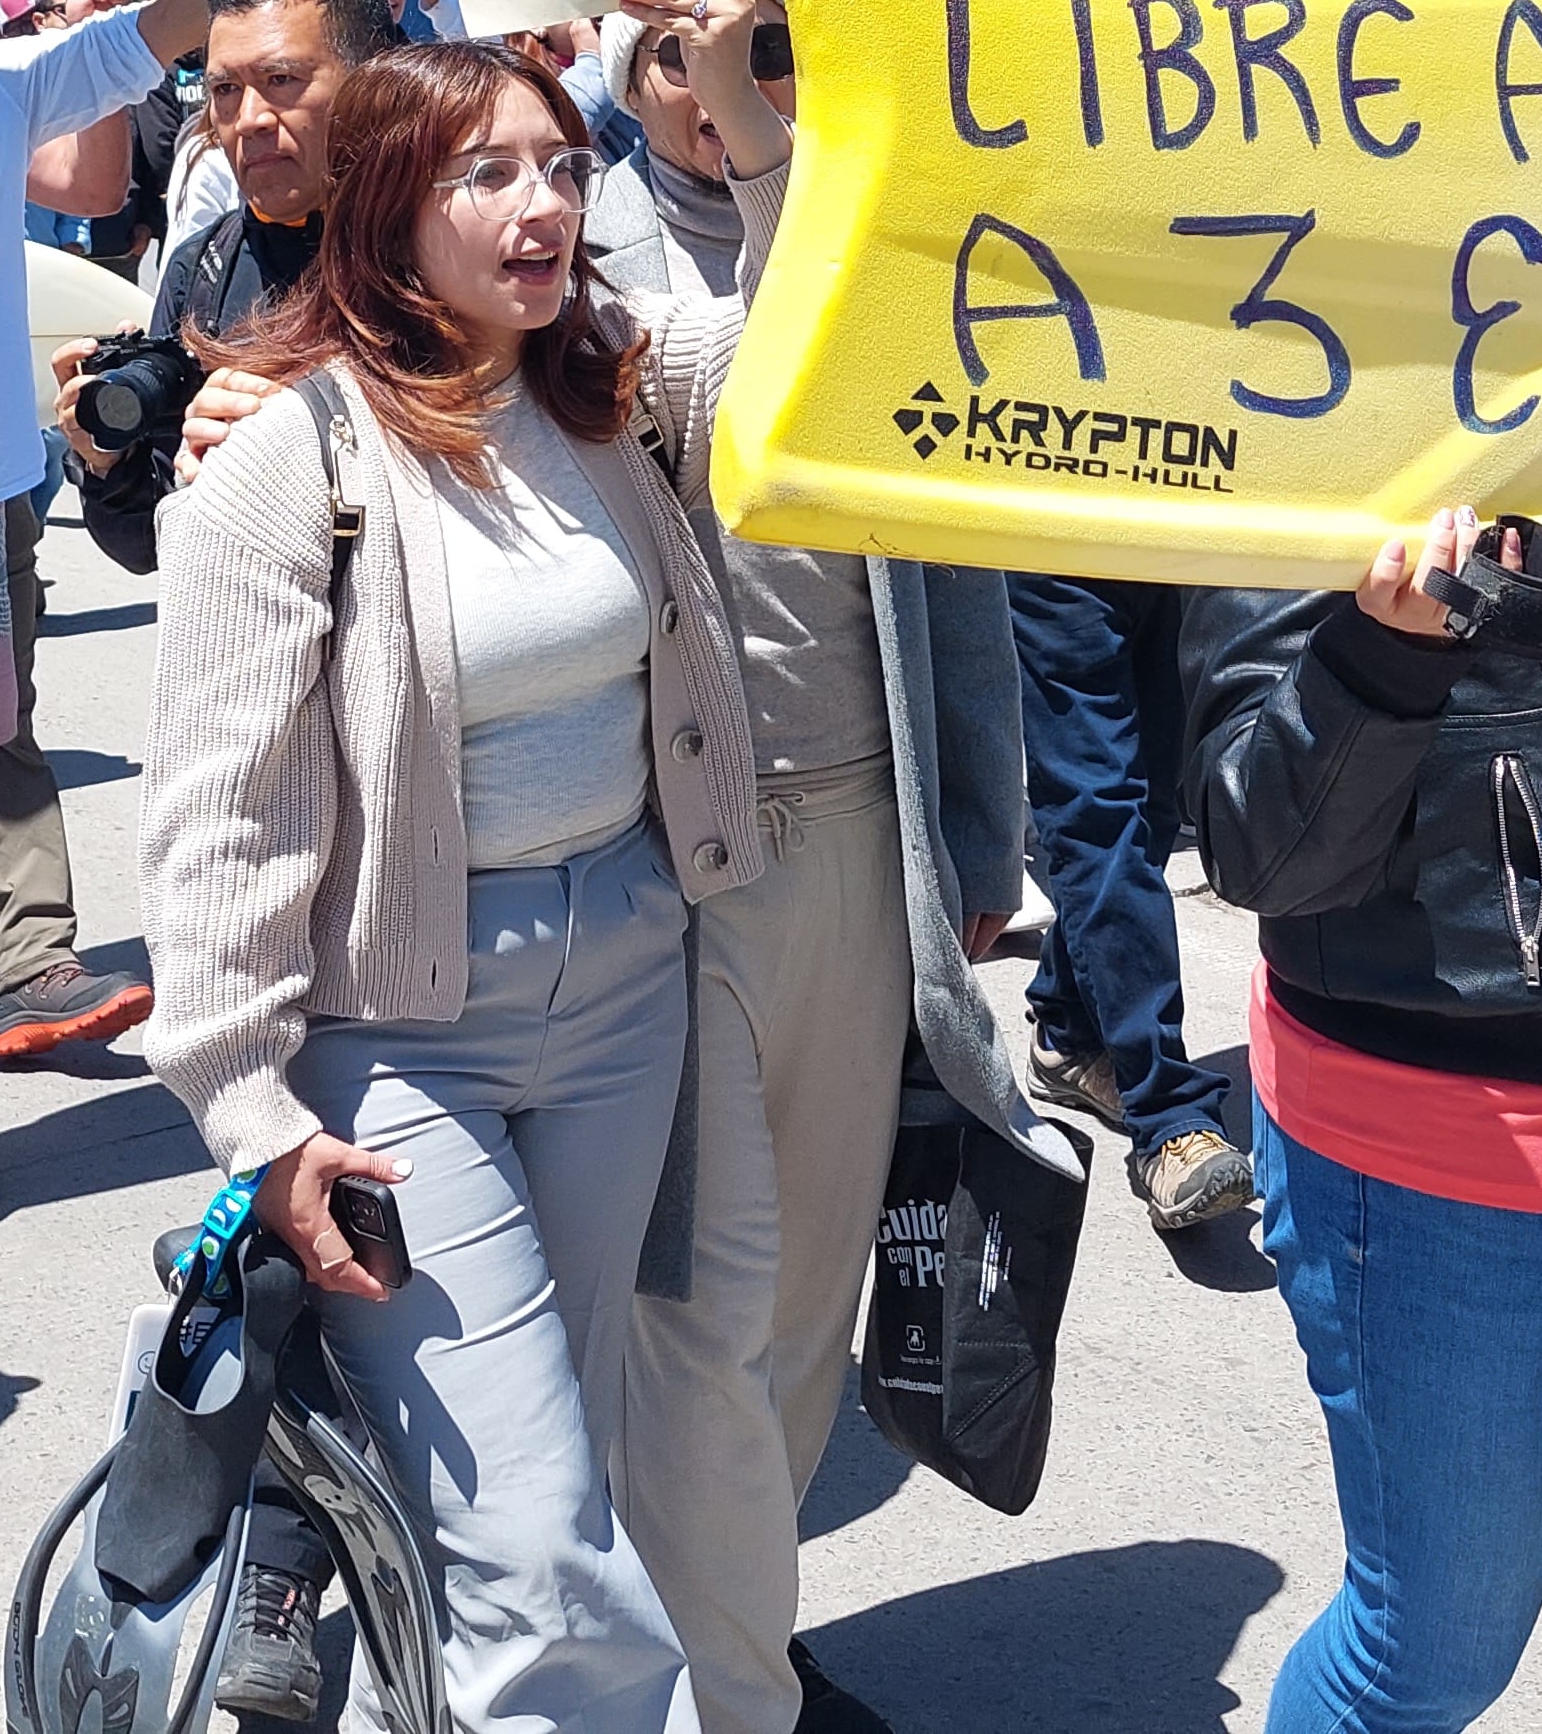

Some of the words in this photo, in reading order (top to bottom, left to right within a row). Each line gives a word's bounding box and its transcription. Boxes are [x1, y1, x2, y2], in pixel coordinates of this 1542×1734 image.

[952, 212, 1107, 387] A
[1168, 207, 1352, 419] 3
[966, 394, 1238, 472] KRYPTON
[964, 443, 1235, 494] HYDRO-HULL
[887, 1244, 913, 1267] con
